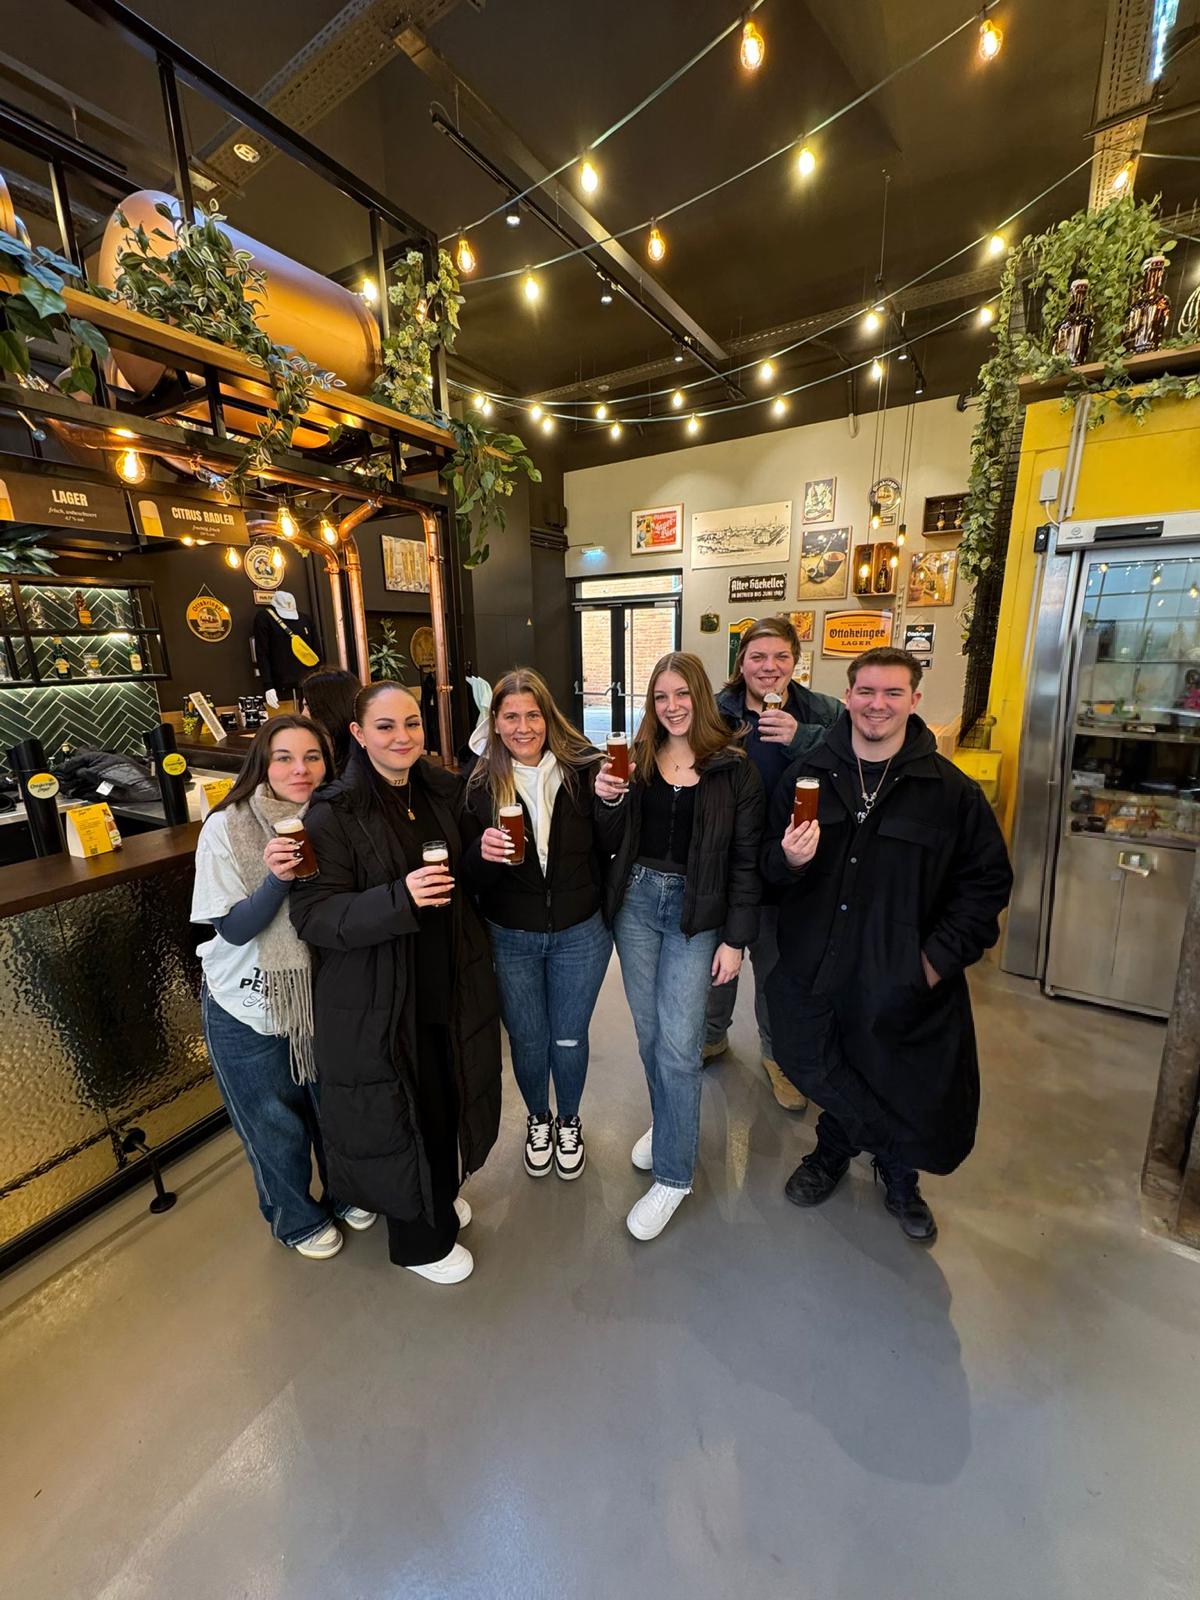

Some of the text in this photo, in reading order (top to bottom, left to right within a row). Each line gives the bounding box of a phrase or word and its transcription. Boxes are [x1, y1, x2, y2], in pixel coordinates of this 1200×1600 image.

[51, 489, 88, 507] LAGER
[171, 507, 235, 526] CITRUS RADLER
[731, 580, 749, 591] Alter
[829, 628, 886, 640] Ottakringer
